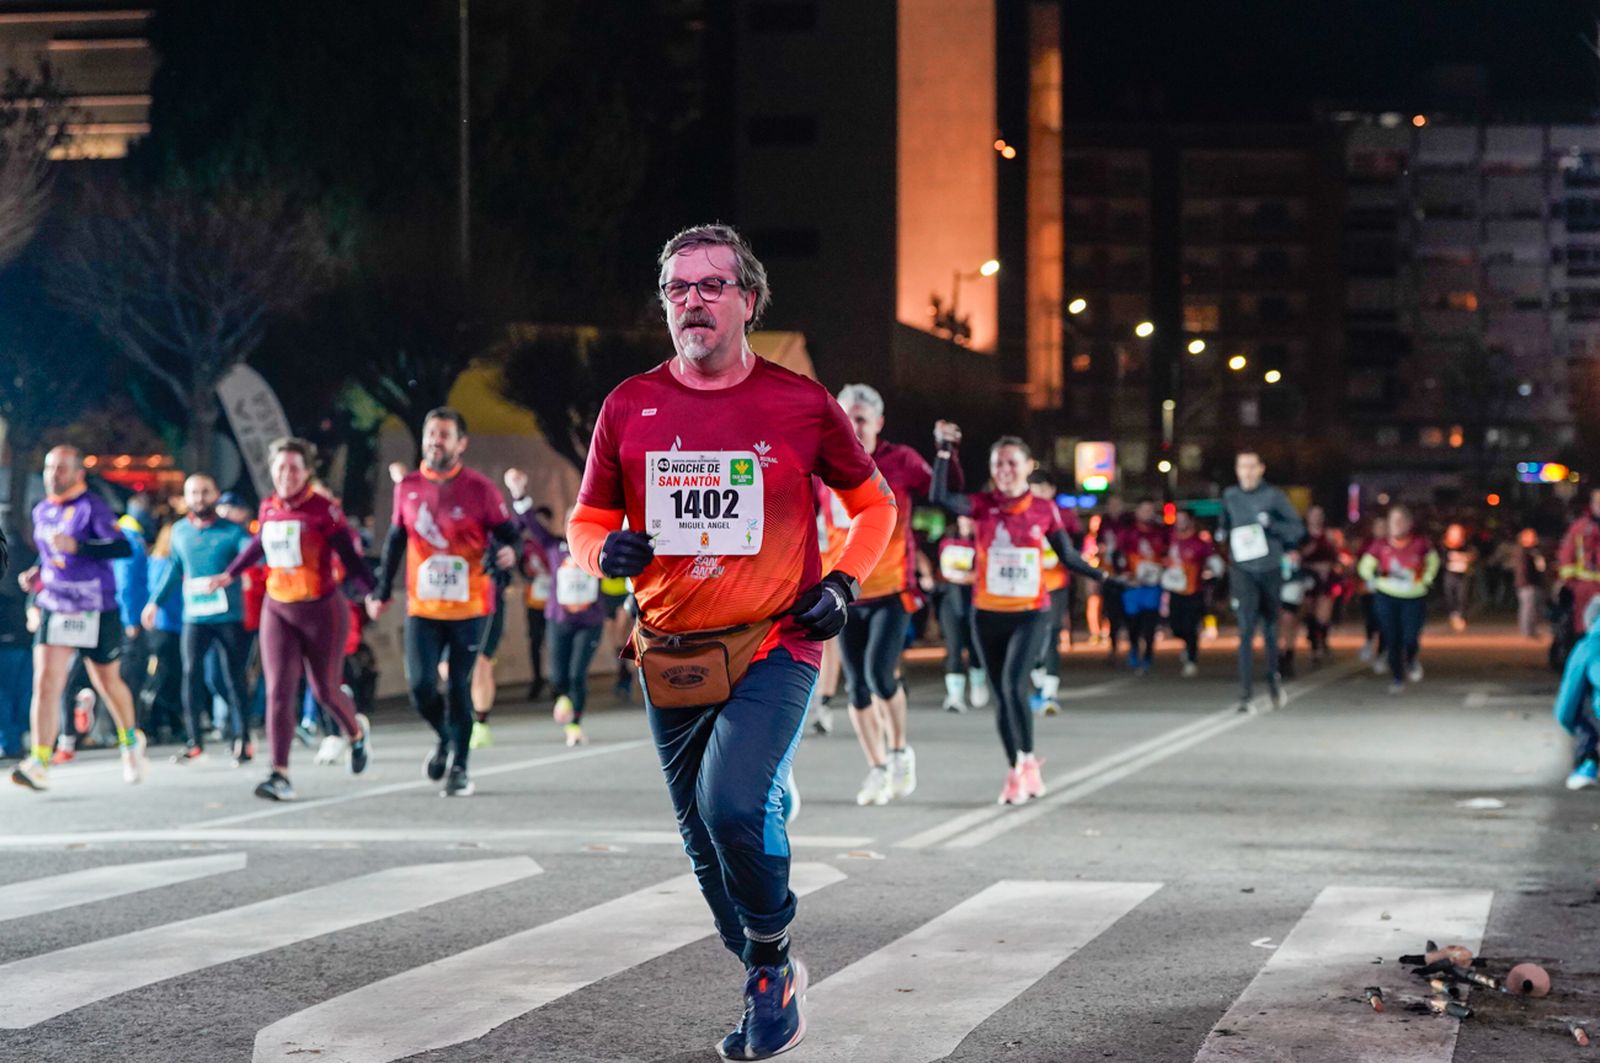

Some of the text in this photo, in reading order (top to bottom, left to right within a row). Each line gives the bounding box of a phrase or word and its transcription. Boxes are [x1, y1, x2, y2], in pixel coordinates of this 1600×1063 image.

[671, 463, 720, 473] NOCHE DE
[658, 473, 720, 487] SAN ANTÓN
[670, 489, 739, 519] 1402
[679, 521, 730, 529] MIGUEL ANGEL
[694, 556, 718, 567] SAN
